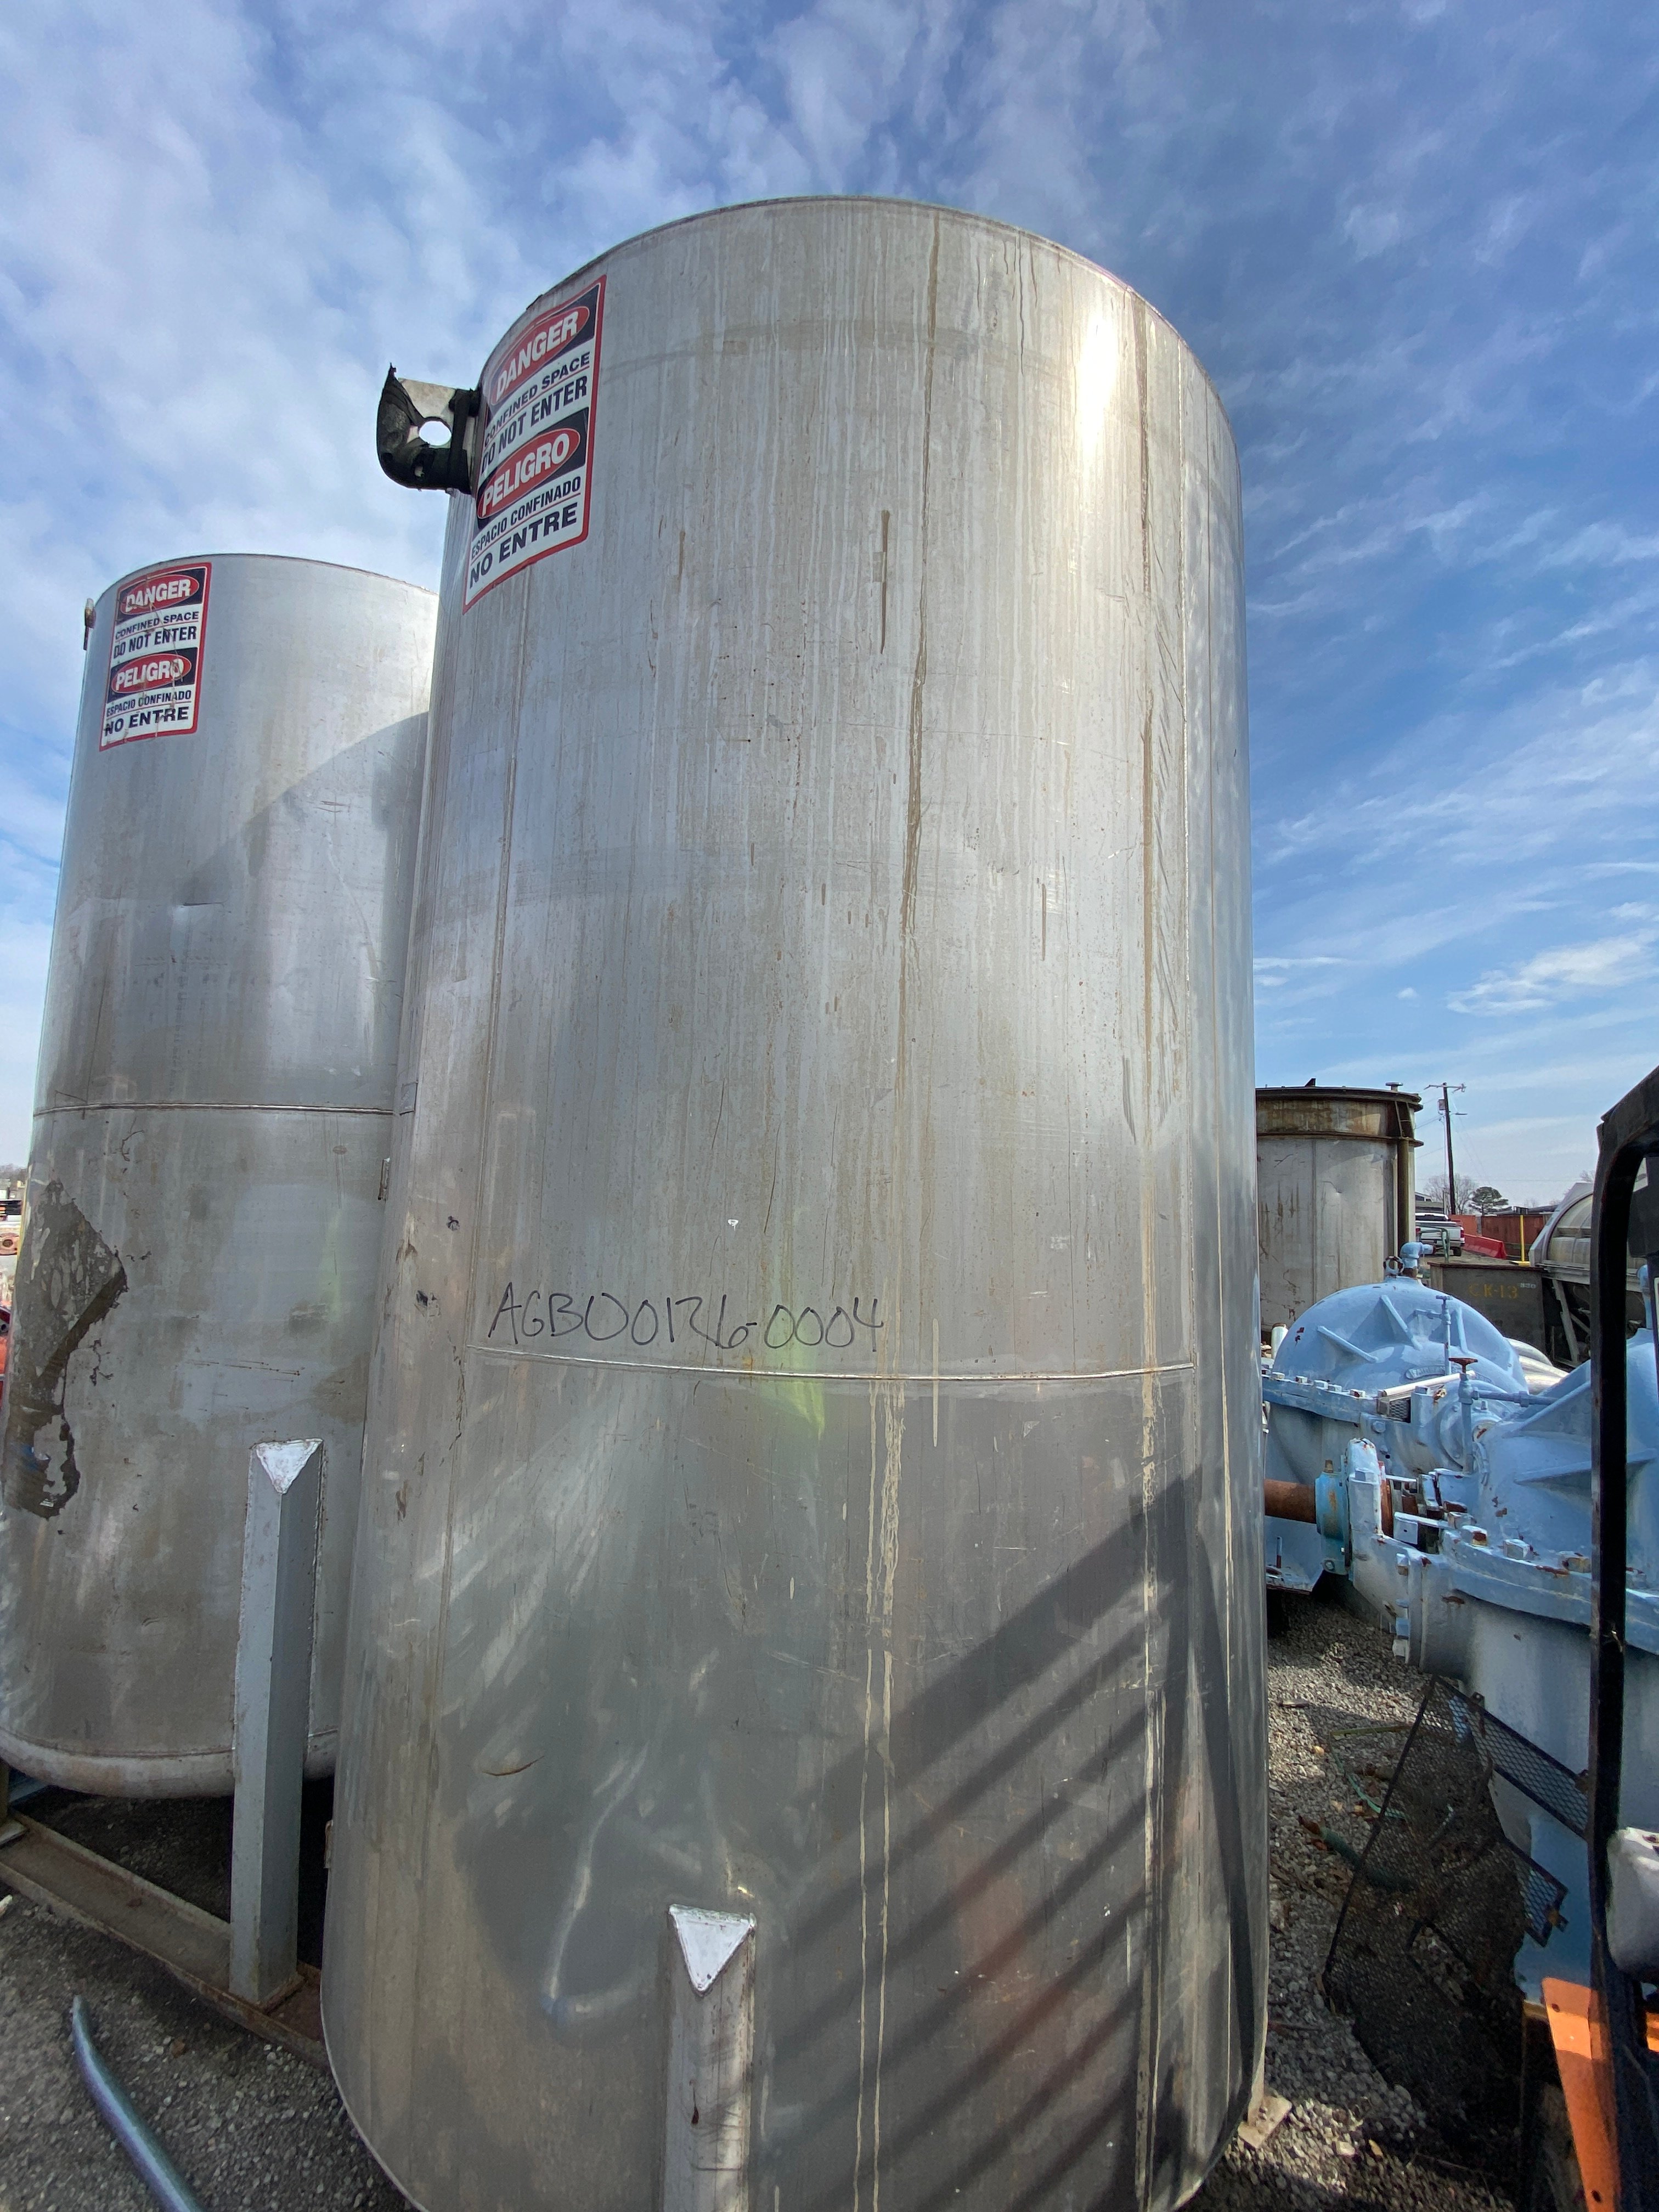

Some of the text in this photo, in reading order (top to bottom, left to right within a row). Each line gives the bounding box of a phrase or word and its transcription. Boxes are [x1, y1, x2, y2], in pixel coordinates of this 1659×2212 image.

[495, 311, 578, 402] DANGER
[481, 375, 588, 475] DO NOT ENTER
[484, 351, 590, 448] CONFINED SPACE
[482, 433, 570, 516] PELIGRO
[470, 503, 578, 589] NO ENTRE
[471, 476, 581, 560] ESPACIO CONFINADO
[125, 579, 191, 612] DANGER
[113, 626, 197, 659] DO NOT ENTER
[115, 611, 199, 640] CONFINED SPACE
[106, 690, 191, 717] ESPACIO CONFINADO
[116, 658, 184, 691] PELIGRO
[104, 706, 189, 736] NO ENTRE
